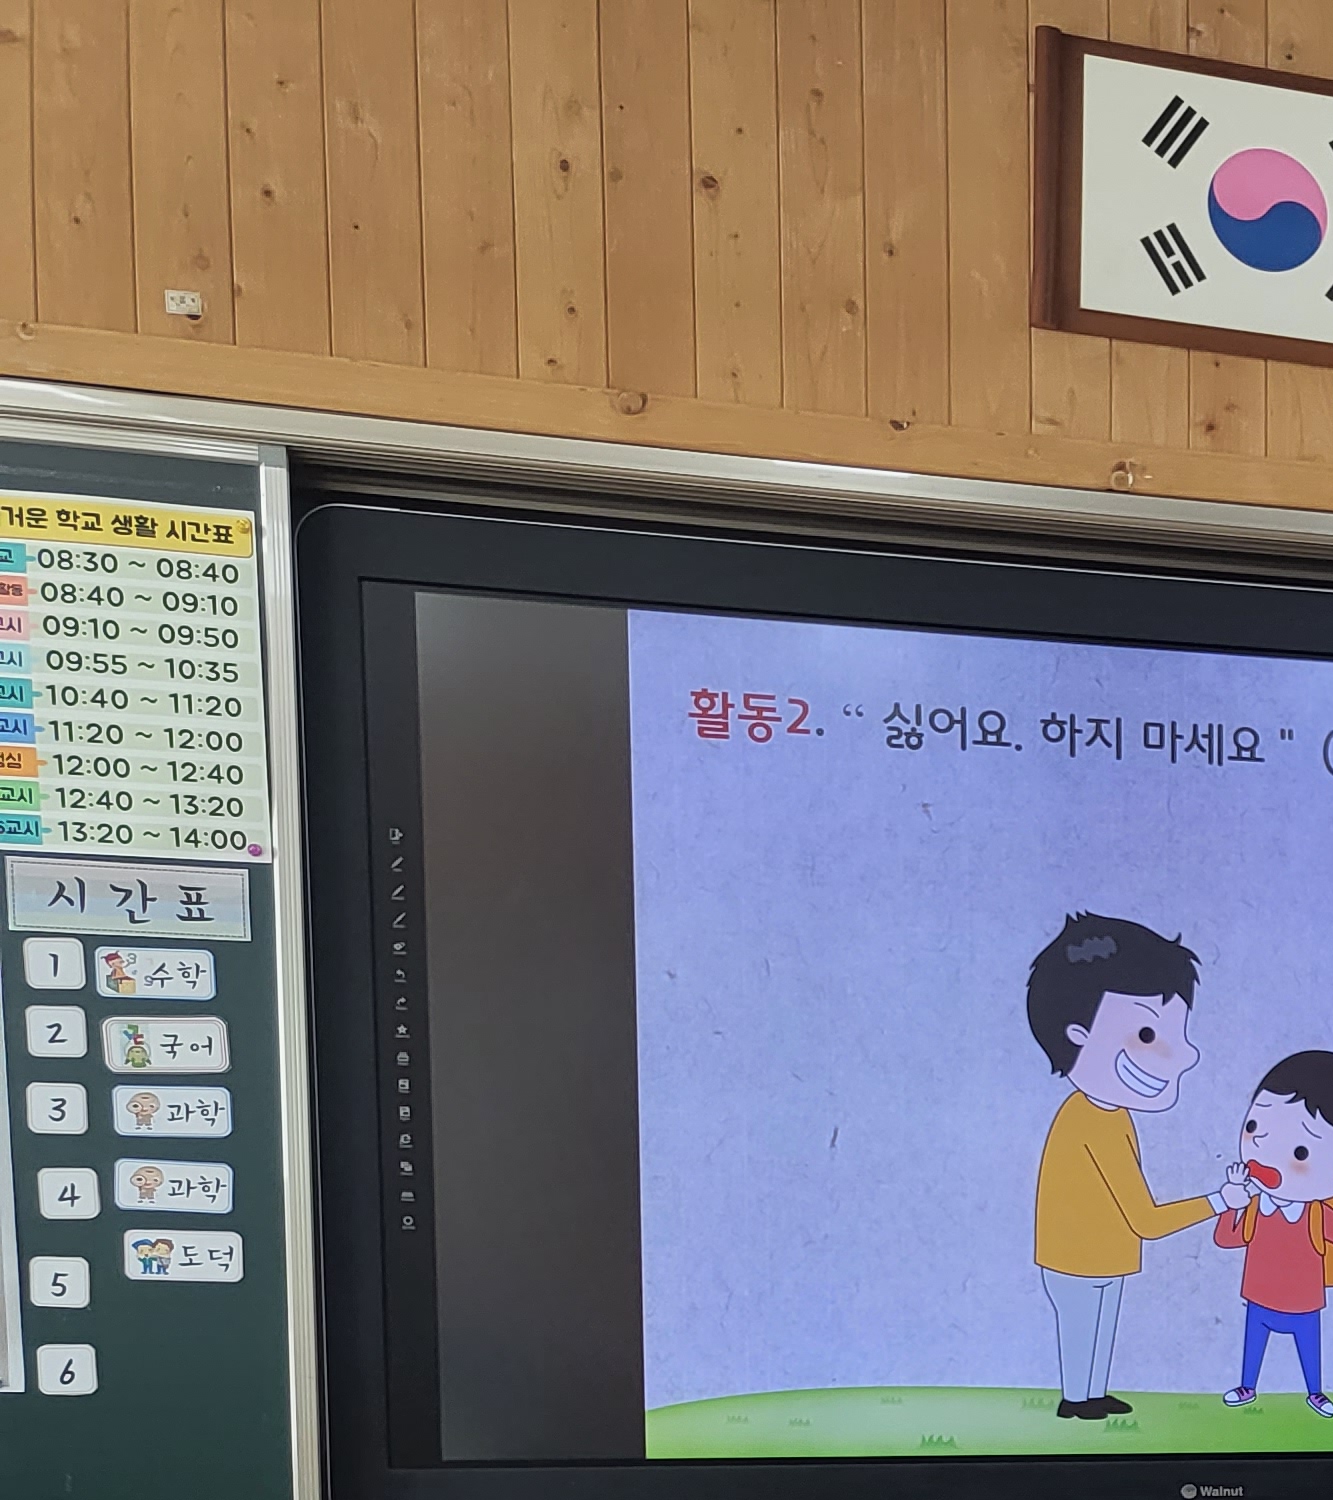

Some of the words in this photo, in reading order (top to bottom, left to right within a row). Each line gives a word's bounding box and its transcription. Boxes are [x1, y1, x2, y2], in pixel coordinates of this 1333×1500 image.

[56, 508, 103, 531] 학교
[111, 514, 158, 538] 생활
[165, 519, 234, 545] 시간표
[37, 548, 118, 574] 08:30
[156, 558, 239, 584] 08:40
[40, 581, 125, 607] 08:40
[162, 590, 238, 616] 09:10
[42, 615, 120, 640] 09:10
[157, 623, 239, 649] 09:50
[46, 649, 128, 675] 09:55
[164, 658, 239, 683] 10:35
[45, 684, 129, 710] 10:40
[168, 693, 242, 717] 11:20
[48, 720, 123, 745] 11:20
[164, 727, 243, 753] 12:00
[688, 688, 825, 742] 활동2.
[882, 702, 1022, 752] 싫어요.
[1040, 712, 1123, 759] 하지
[1143, 720, 1265, 765] 마세요
[52, 754, 130, 779] 12:00
[167, 760, 244, 786] 12:40
[55, 787, 133, 812] 12:40
[169, 794, 244, 818] 13:20
[57, 821, 133, 846] 13:20
[170, 826, 247, 851] 14:00
[49, 952, 60, 979] 1
[151, 961, 207, 989] 수학
[46, 1022, 67, 1045] 2
[160, 1033, 213, 1059] 국어
[47, 1097, 67, 1123] 3
[166, 1099, 225, 1125] 과학
[57, 1181, 81, 1209] 4
[167, 1174, 227, 1200] 과학
[178, 1243, 235, 1272] 도덕
[51, 1272, 68, 1298] 5
[59, 1357, 75, 1386] 6
[1200, 1485, 1244, 1498] Walnut
